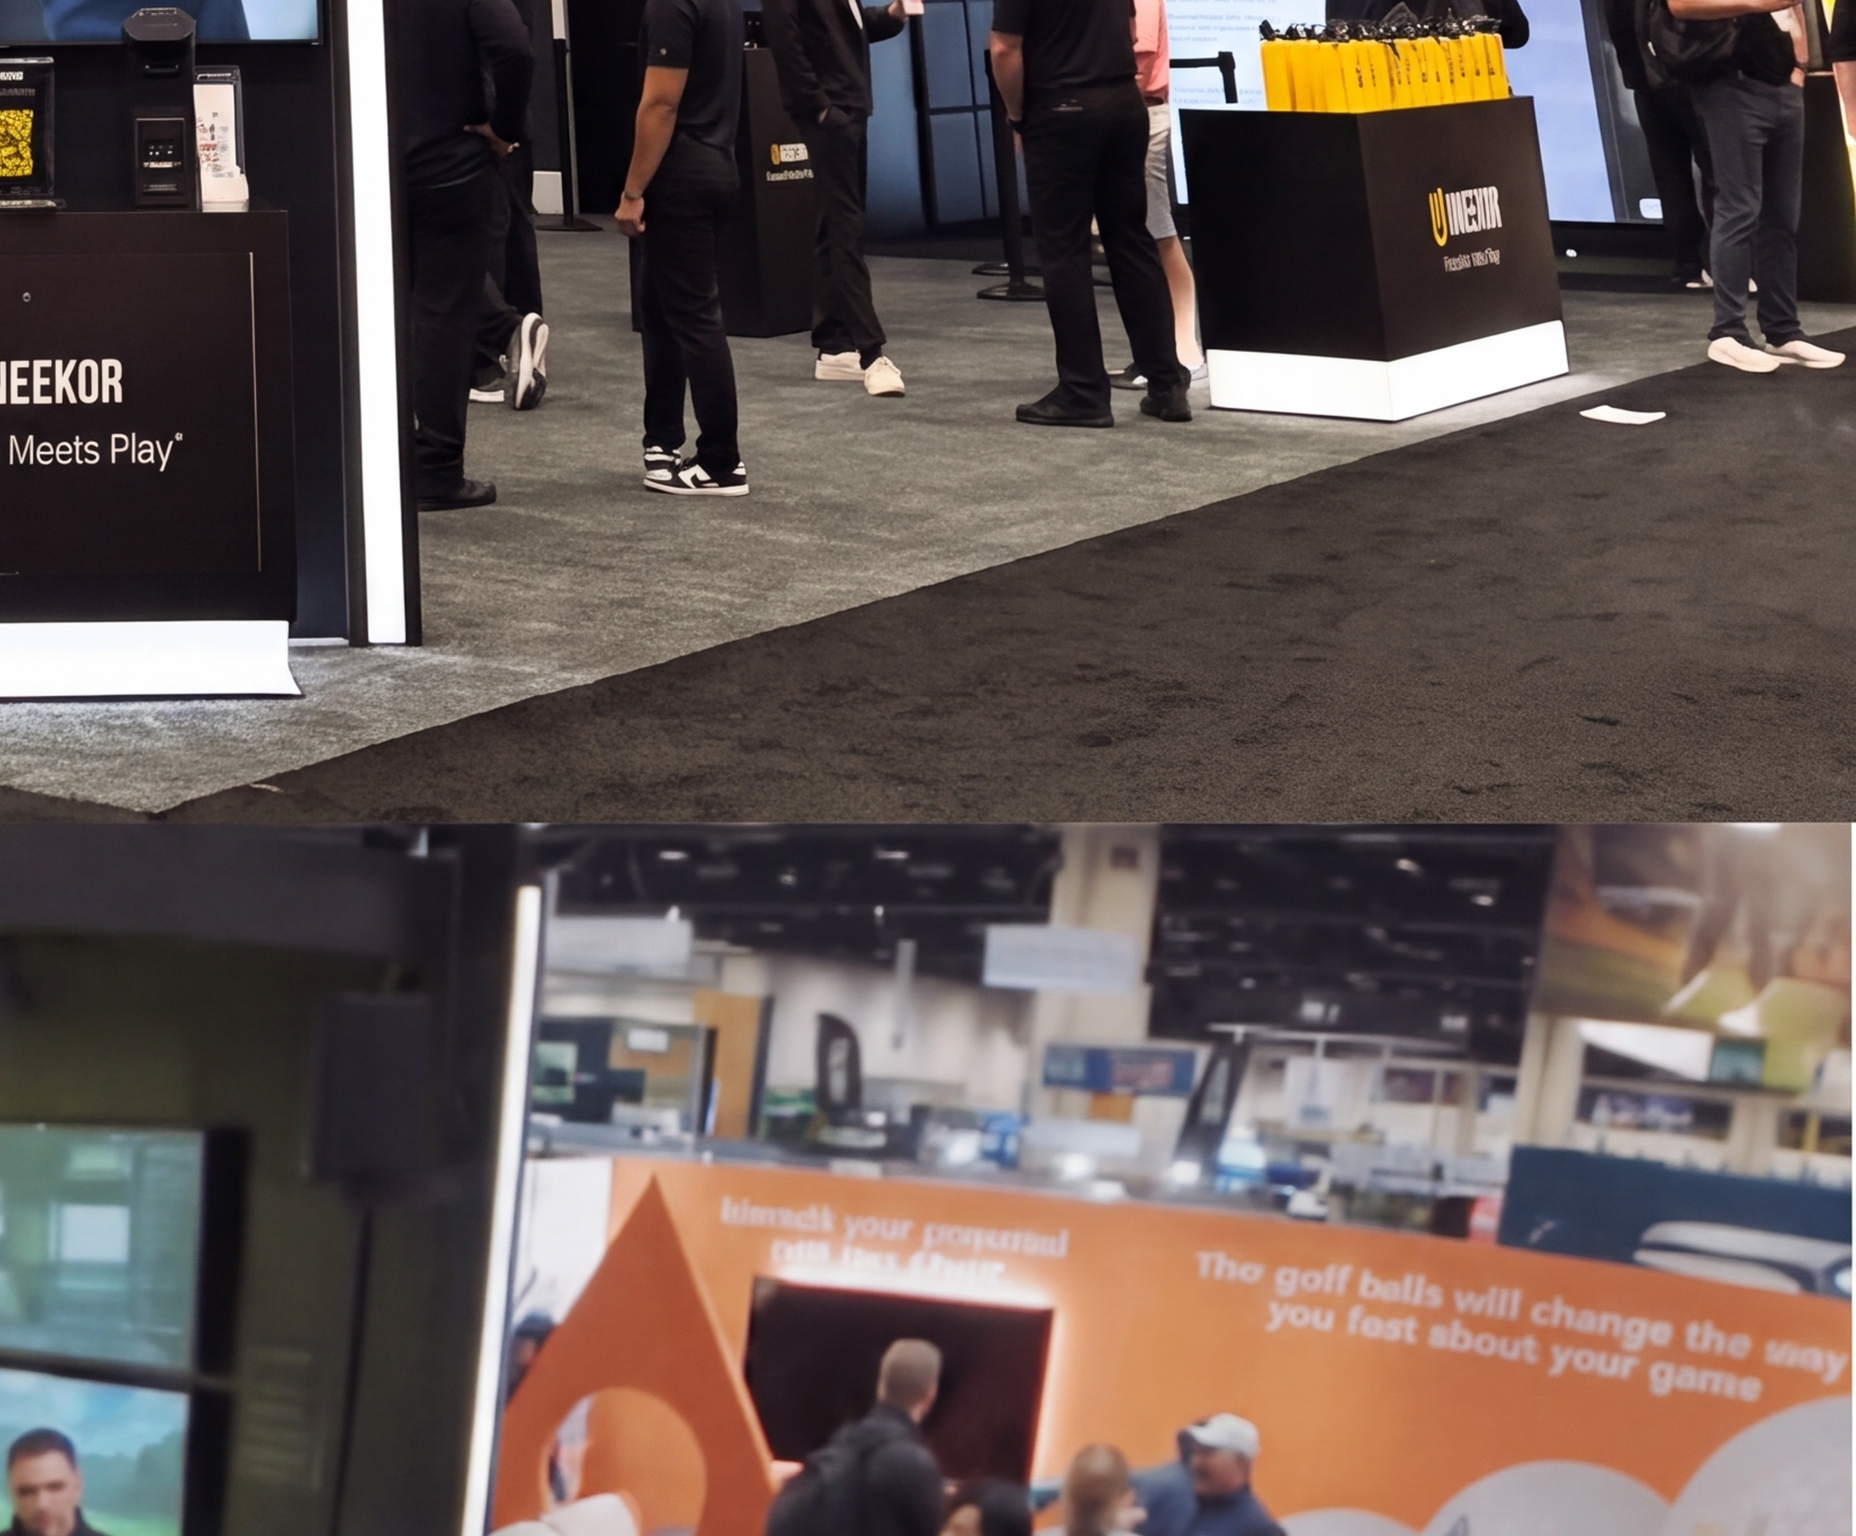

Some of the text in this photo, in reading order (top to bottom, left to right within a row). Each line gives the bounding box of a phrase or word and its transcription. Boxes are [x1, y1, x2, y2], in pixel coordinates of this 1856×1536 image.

[8, 433, 101, 466] Meets
[1265, 1301, 1336, 1333] you
[1547, 1342, 1641, 1380] your
[1648, 1359, 1763, 1403] game
[1453, 1287, 1523, 1321] will
[1530, 1298, 1674, 1350] change
[1685, 1319, 1752, 1357] the
